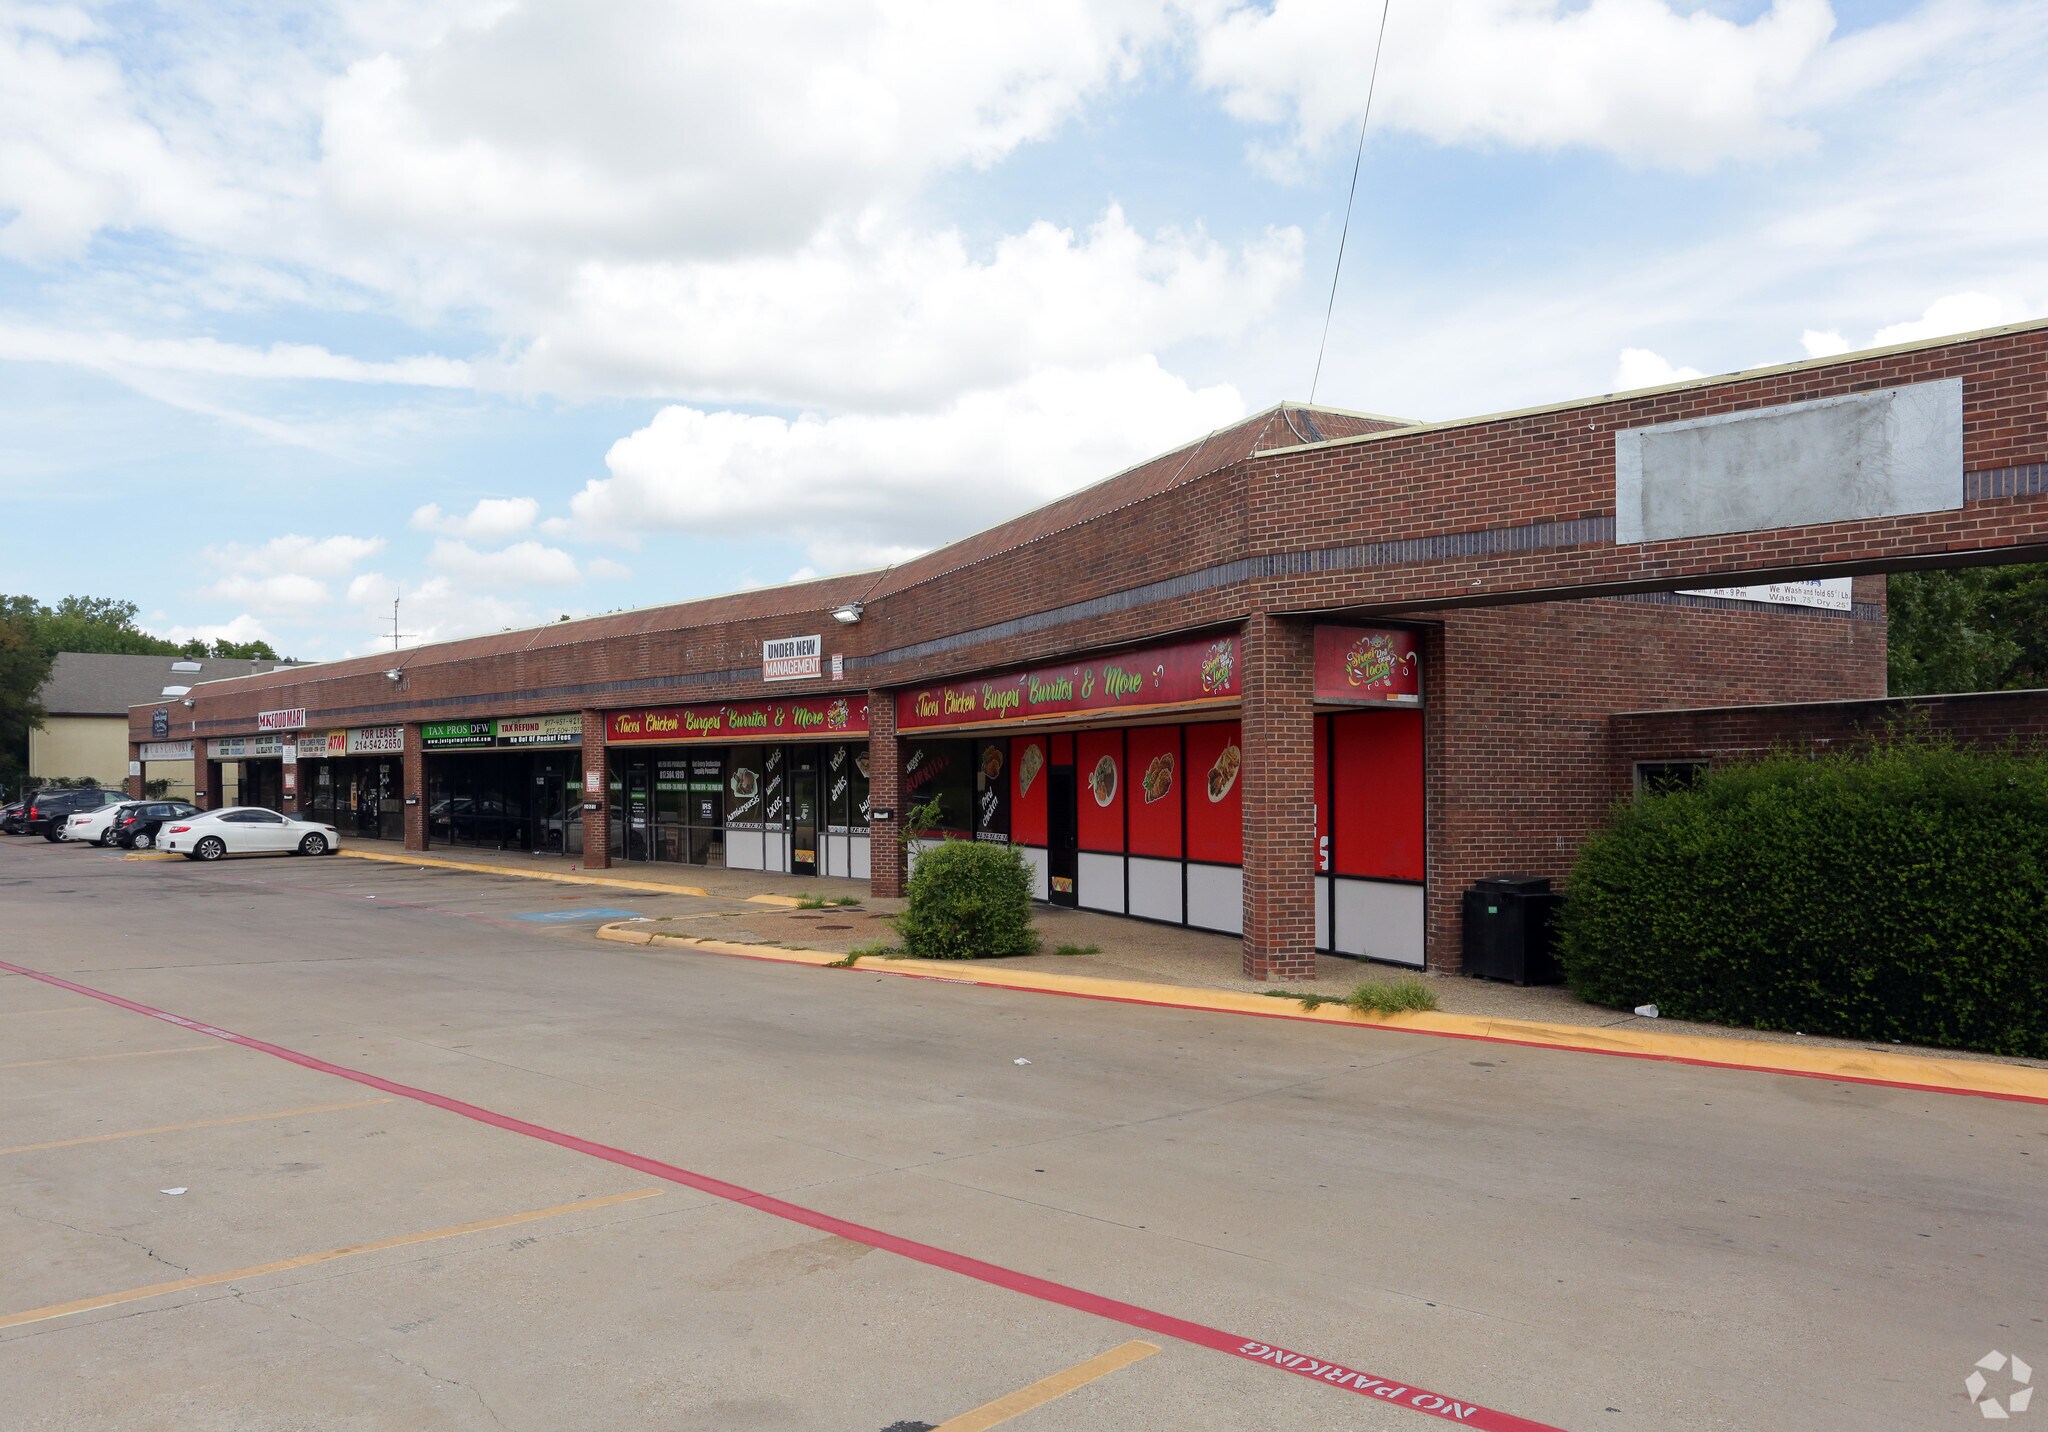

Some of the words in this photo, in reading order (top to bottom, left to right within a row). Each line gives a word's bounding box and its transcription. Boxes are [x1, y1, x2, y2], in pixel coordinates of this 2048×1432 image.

[1730, 588, 1734, 597] 9
[1769, 585, 1780, 593] We
[1785, 586, 1802, 594] Wash
[1815, 589, 1825, 598] fold
[1769, 593, 1797, 602] Wash
[1817, 598, 1831, 607] Dry
[768, 642, 795, 659] UNDER
[796, 639, 815, 656] NEW
[765, 659, 819, 677] MANAGEMENT
[918, 691, 939, 717] Tacos
[944, 686, 976, 714] Chicken
[982, 683, 1020, 718] Burgers
[1028, 674, 1074, 704] Burritos
[1081, 668, 1094, 699] &
[1103, 665, 1142, 700] More
[287, 709, 304, 727] MART
[618, 714, 640, 733] Tacos
[646, 712, 679, 732] Chicken
[684, 711, 720, 736] Burgers
[727, 708, 767, 728] Burritos
[774, 706, 785, 727] &
[792, 705, 824, 729] More
[361, 730, 374, 739] FOR
[376, 728, 397, 738] LEASE
[427, 726, 444, 735] TAX
[446, 725, 468, 735] PROS
[470, 723, 490, 733] DFW
[501, 724, 513, 732] TAX
[514, 723, 539, 732] REFUND
[328, 735, 345, 749] ATM
[354, 738, 402, 750] 214-542-2650
[1239, 1341, 1408, 1399] PARKING
[1411, 1394, 1477, 1419] NO
